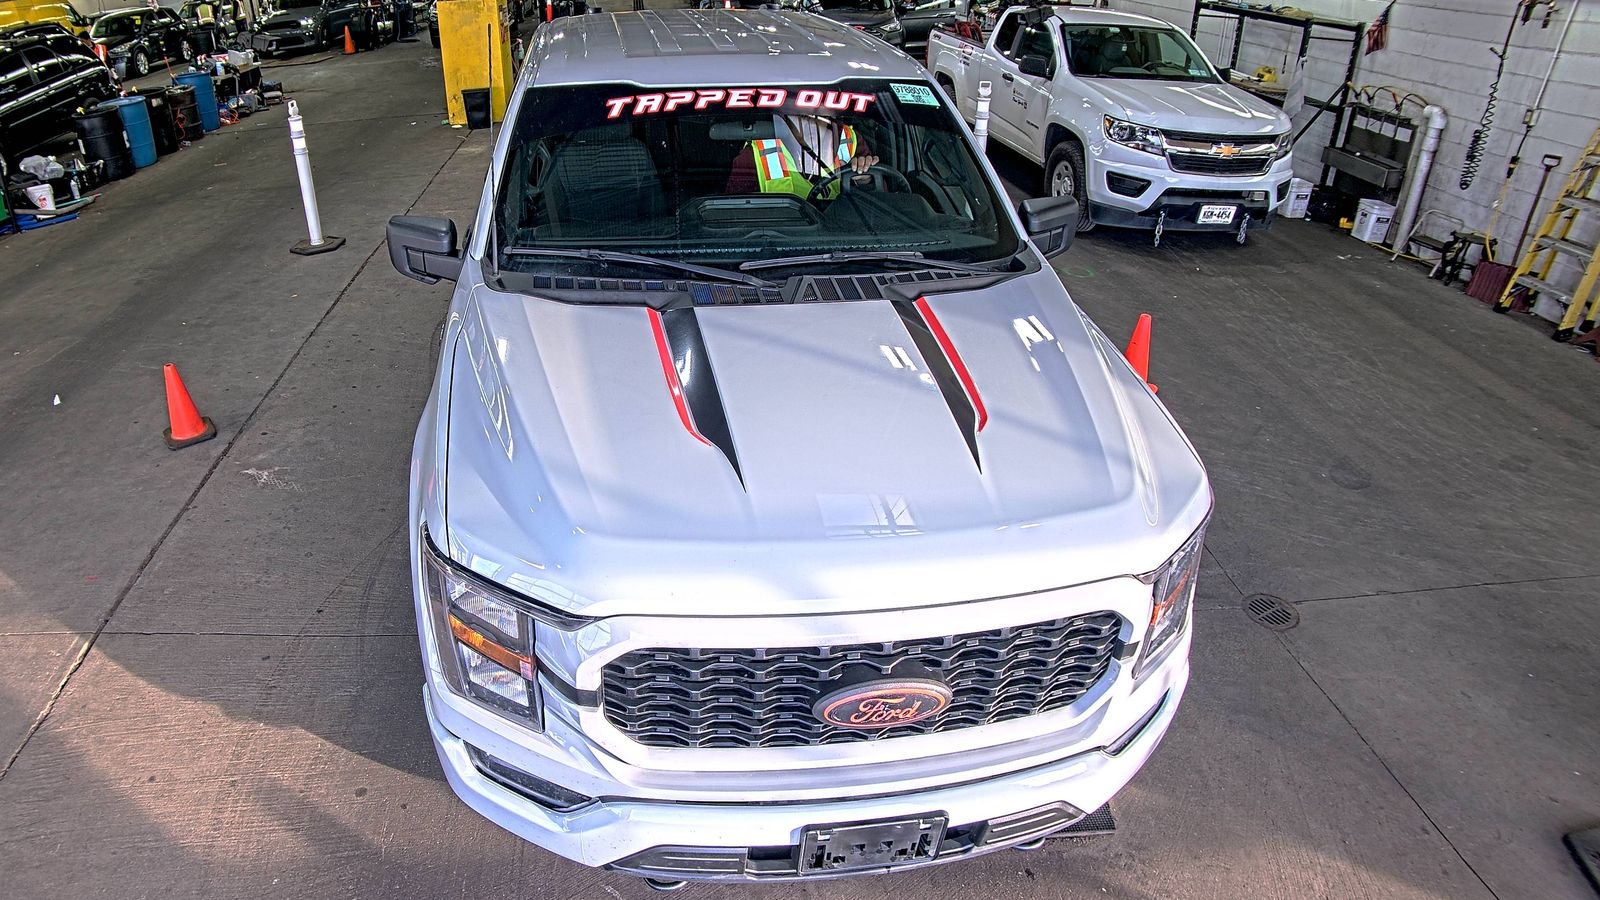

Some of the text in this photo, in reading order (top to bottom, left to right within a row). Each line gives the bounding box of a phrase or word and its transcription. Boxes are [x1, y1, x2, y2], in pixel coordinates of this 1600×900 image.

[605, 88, 876, 119] TAPPED OUT
[893, 85, 930, 96] 9788010
[850, 696, 922, 723] Ford
